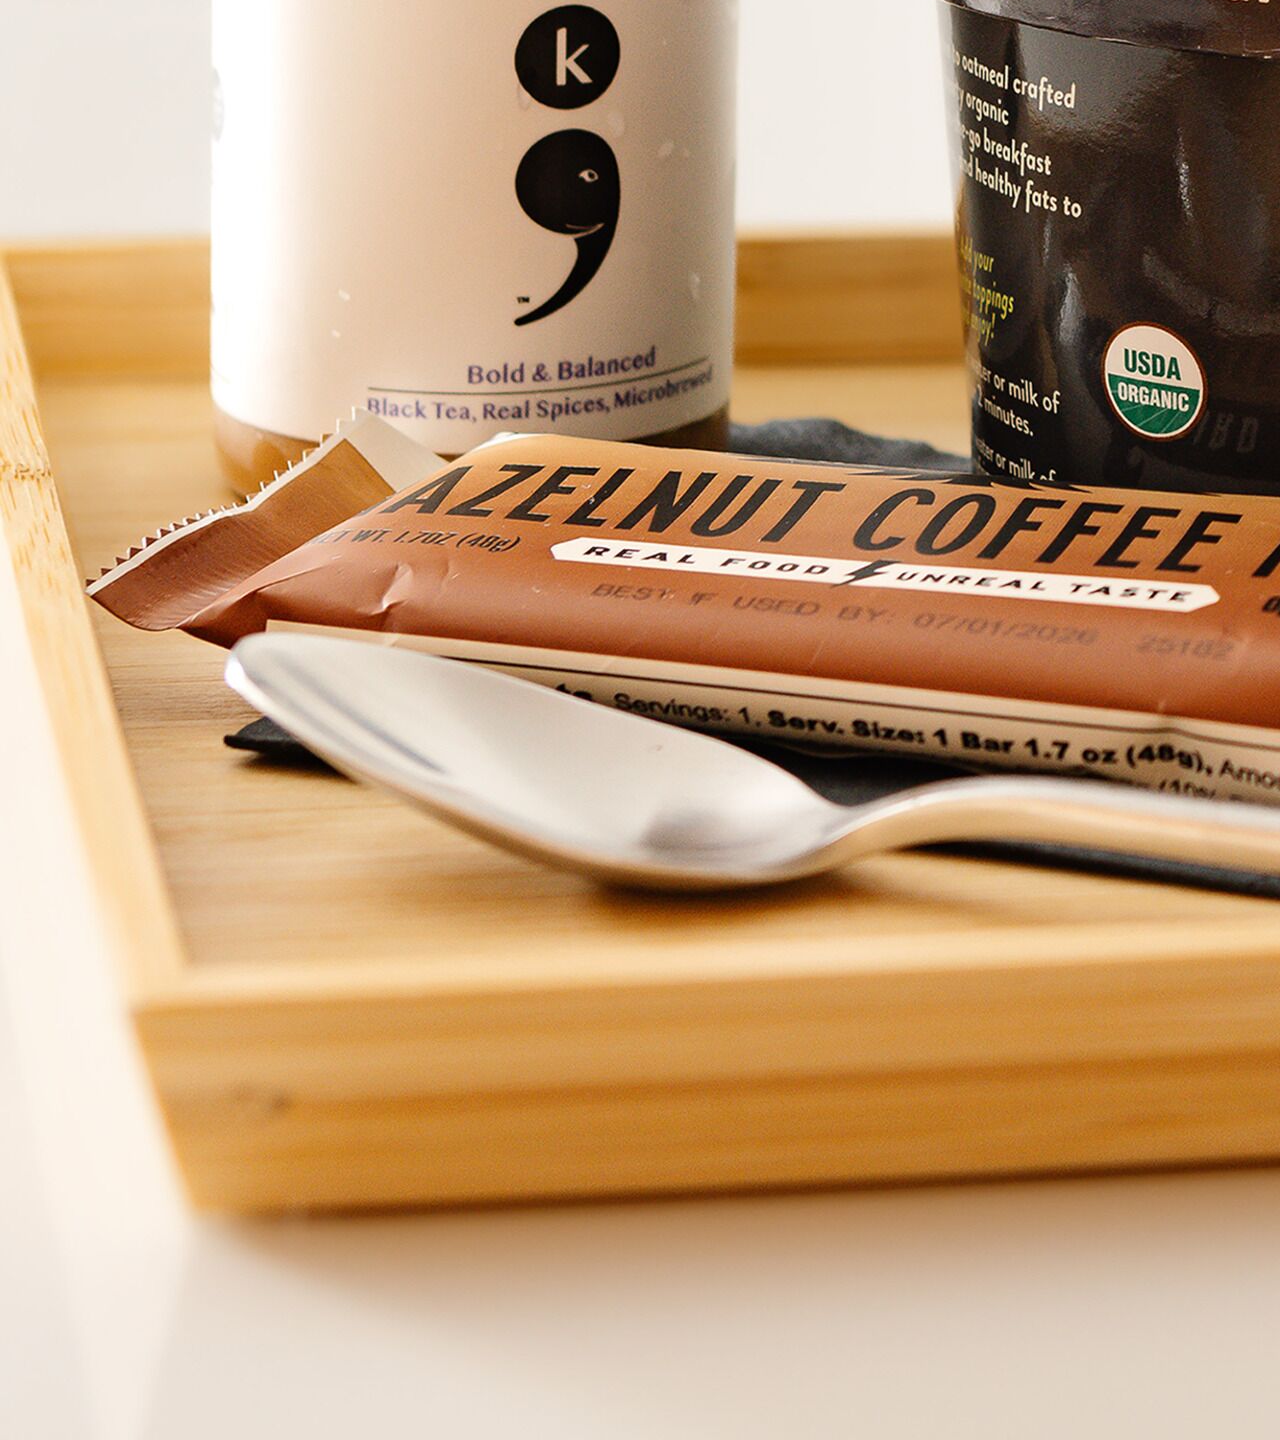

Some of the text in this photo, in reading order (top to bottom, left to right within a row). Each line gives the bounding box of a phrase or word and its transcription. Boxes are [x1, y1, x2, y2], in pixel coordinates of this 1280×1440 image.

[961, 54, 1009, 90] oatmeal
[1012, 75, 1077, 111] crafted
[965, 92, 1010, 127] organic
[983, 126, 1053, 178] breakfast
[975, 157, 1022, 210] healthy
[1025, 180, 1059, 214] fats
[1062, 195, 1083, 219] to
[973, 250, 995, 275] your
[467, 346, 658, 385] Bold & Balanced
[1123, 347, 1182, 381] USDA
[366, 397, 427, 420] Black
[433, 402, 478, 424] Tea,
[482, 397, 531, 421] Real
[536, 391, 612, 423] Spices,
[993, 373, 1006, 392] or
[1008, 378, 1040, 409] milk
[1042, 390, 1061, 414] of
[1117, 381, 1190, 413] ORGANIC
[984, 395, 1035, 437] minutes.
[361, 463, 848, 543] AZELNUT
[852, 487, 1244, 574] COFFEE
[583, 545, 1193, 604] REAL FOOD UNREAL TASTE
[614, 691, 730, 724] Servings:
[767, 708, 846, 736] Serv.
[851, 718, 926, 745] Size:
[960, 730, 1015, 755] Bar
[1023, 737, 1070, 762] 1.7
[1080, 747, 1117, 766] oz
